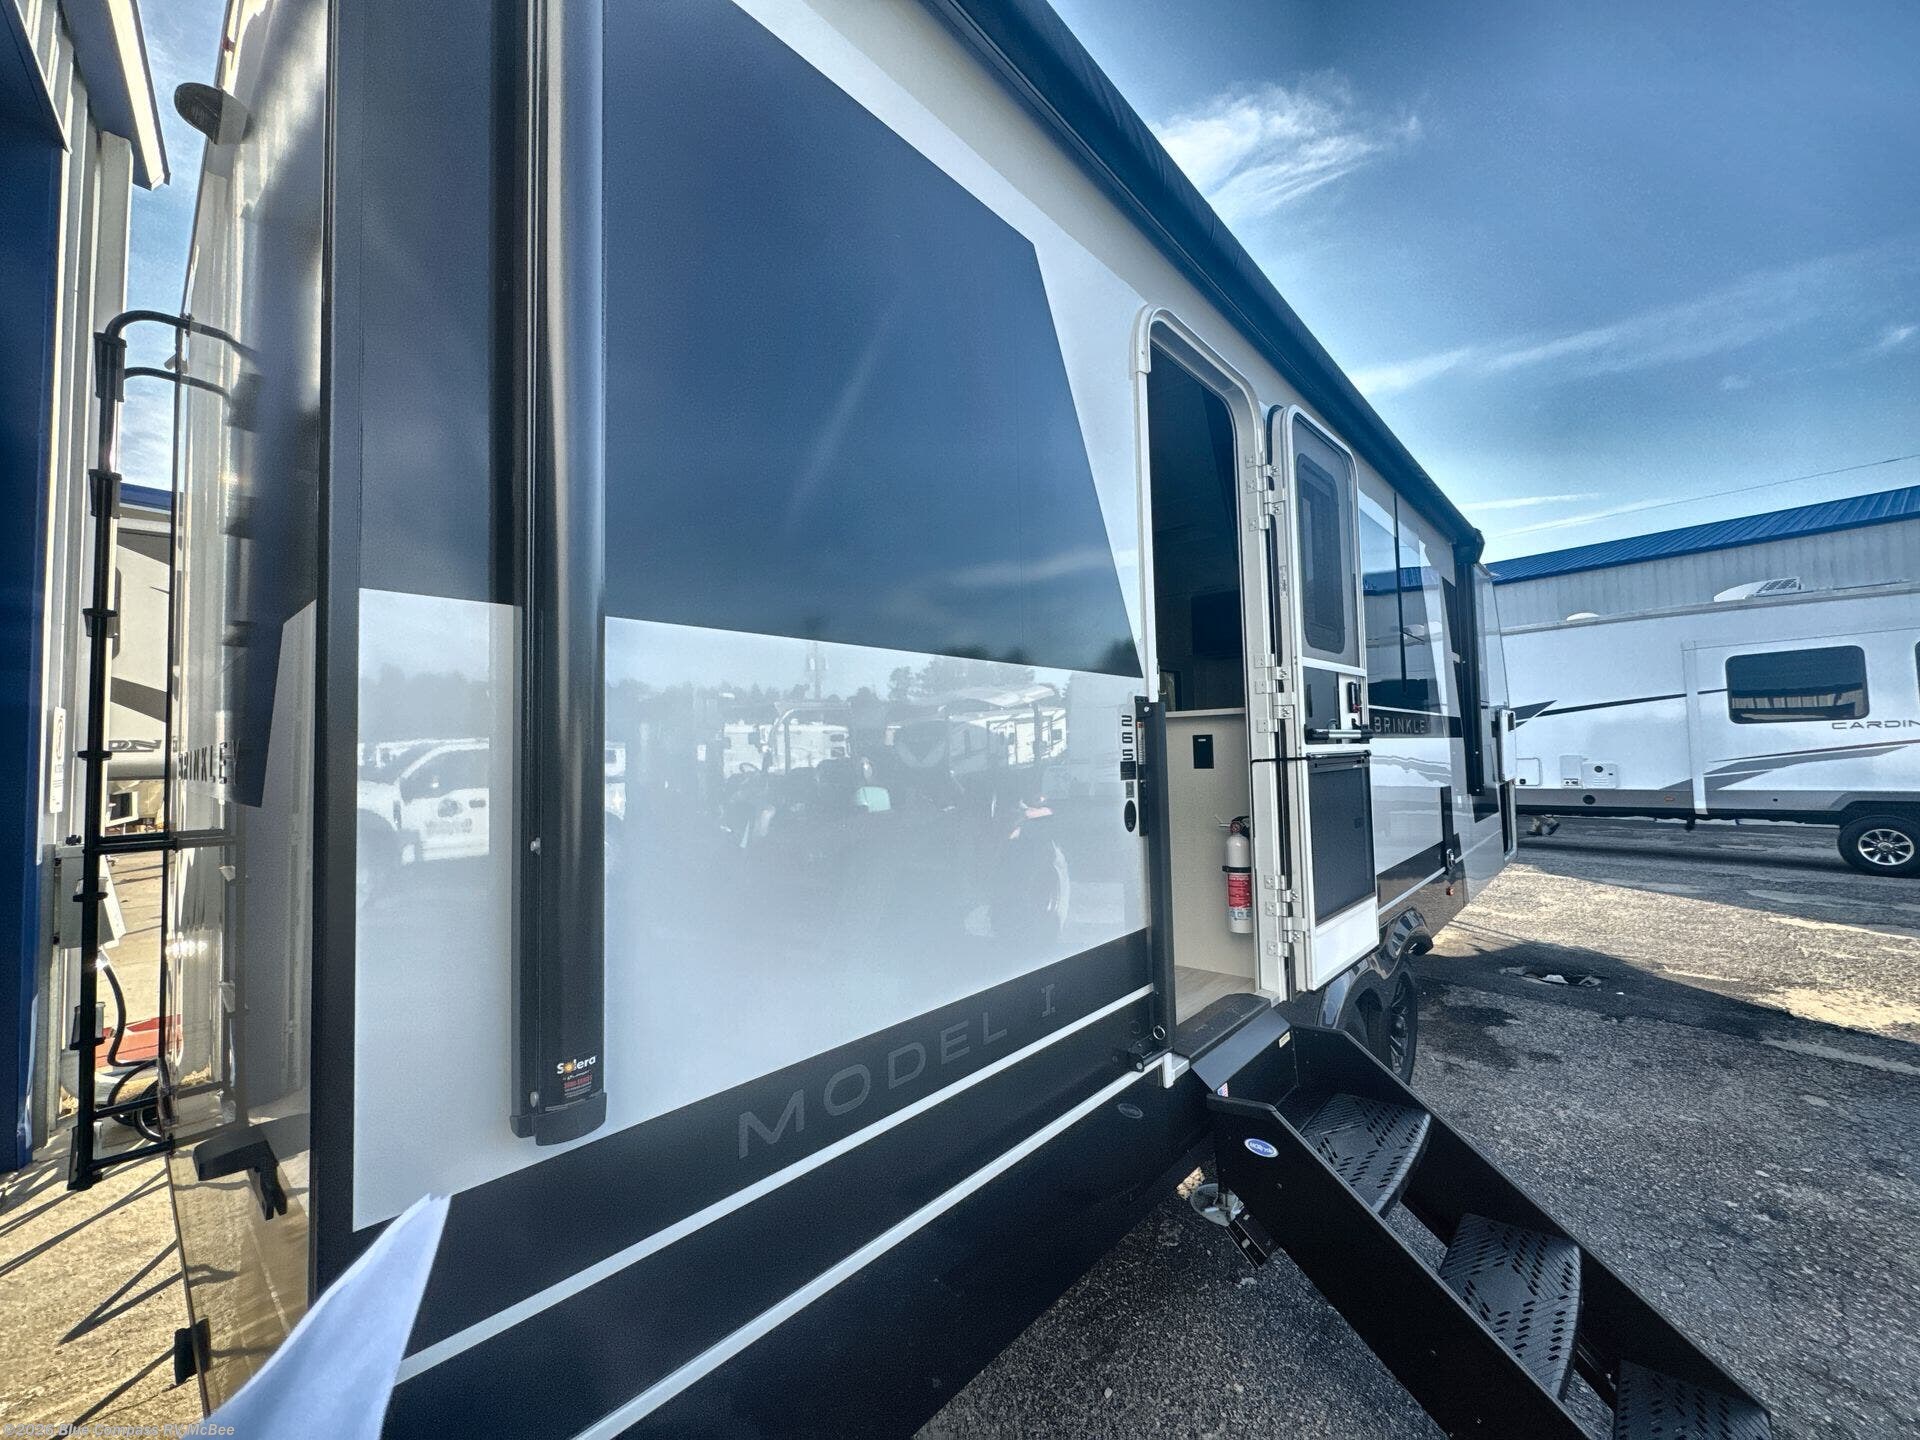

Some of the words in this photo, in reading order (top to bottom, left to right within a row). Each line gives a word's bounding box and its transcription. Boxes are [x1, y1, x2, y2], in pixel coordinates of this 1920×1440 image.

[1832, 720, 1920, 729] CARDIN
[556, 1055, 597, 1074] Solera
[738, 1012, 1008, 1160] MODEL
